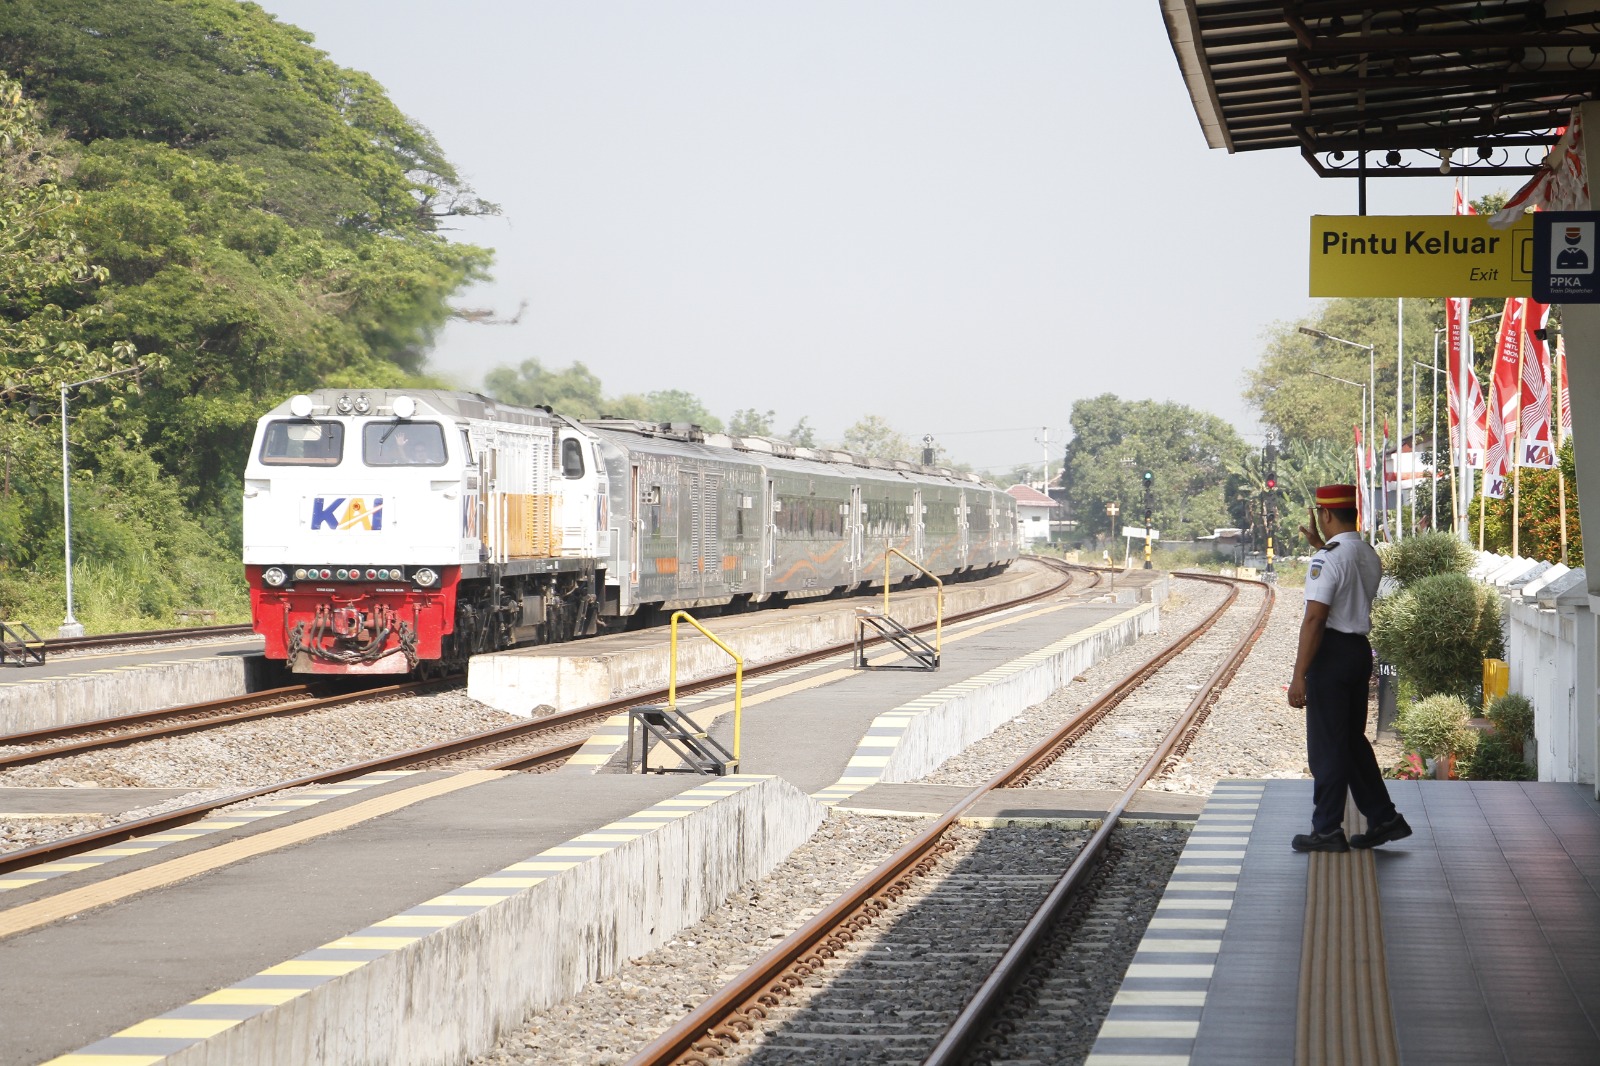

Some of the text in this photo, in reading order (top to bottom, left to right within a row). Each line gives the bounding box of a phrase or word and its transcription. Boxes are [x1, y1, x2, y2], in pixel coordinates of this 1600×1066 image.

[1322, 230, 1500, 255] Pintu Keluar
[1469, 267, 1499, 281] Exit
[1550, 277, 1581, 287] PPKA
[925, 434, 932, 443] 3
[1268, 431, 1274, 441] 3
[311, 497, 384, 531] KAI
